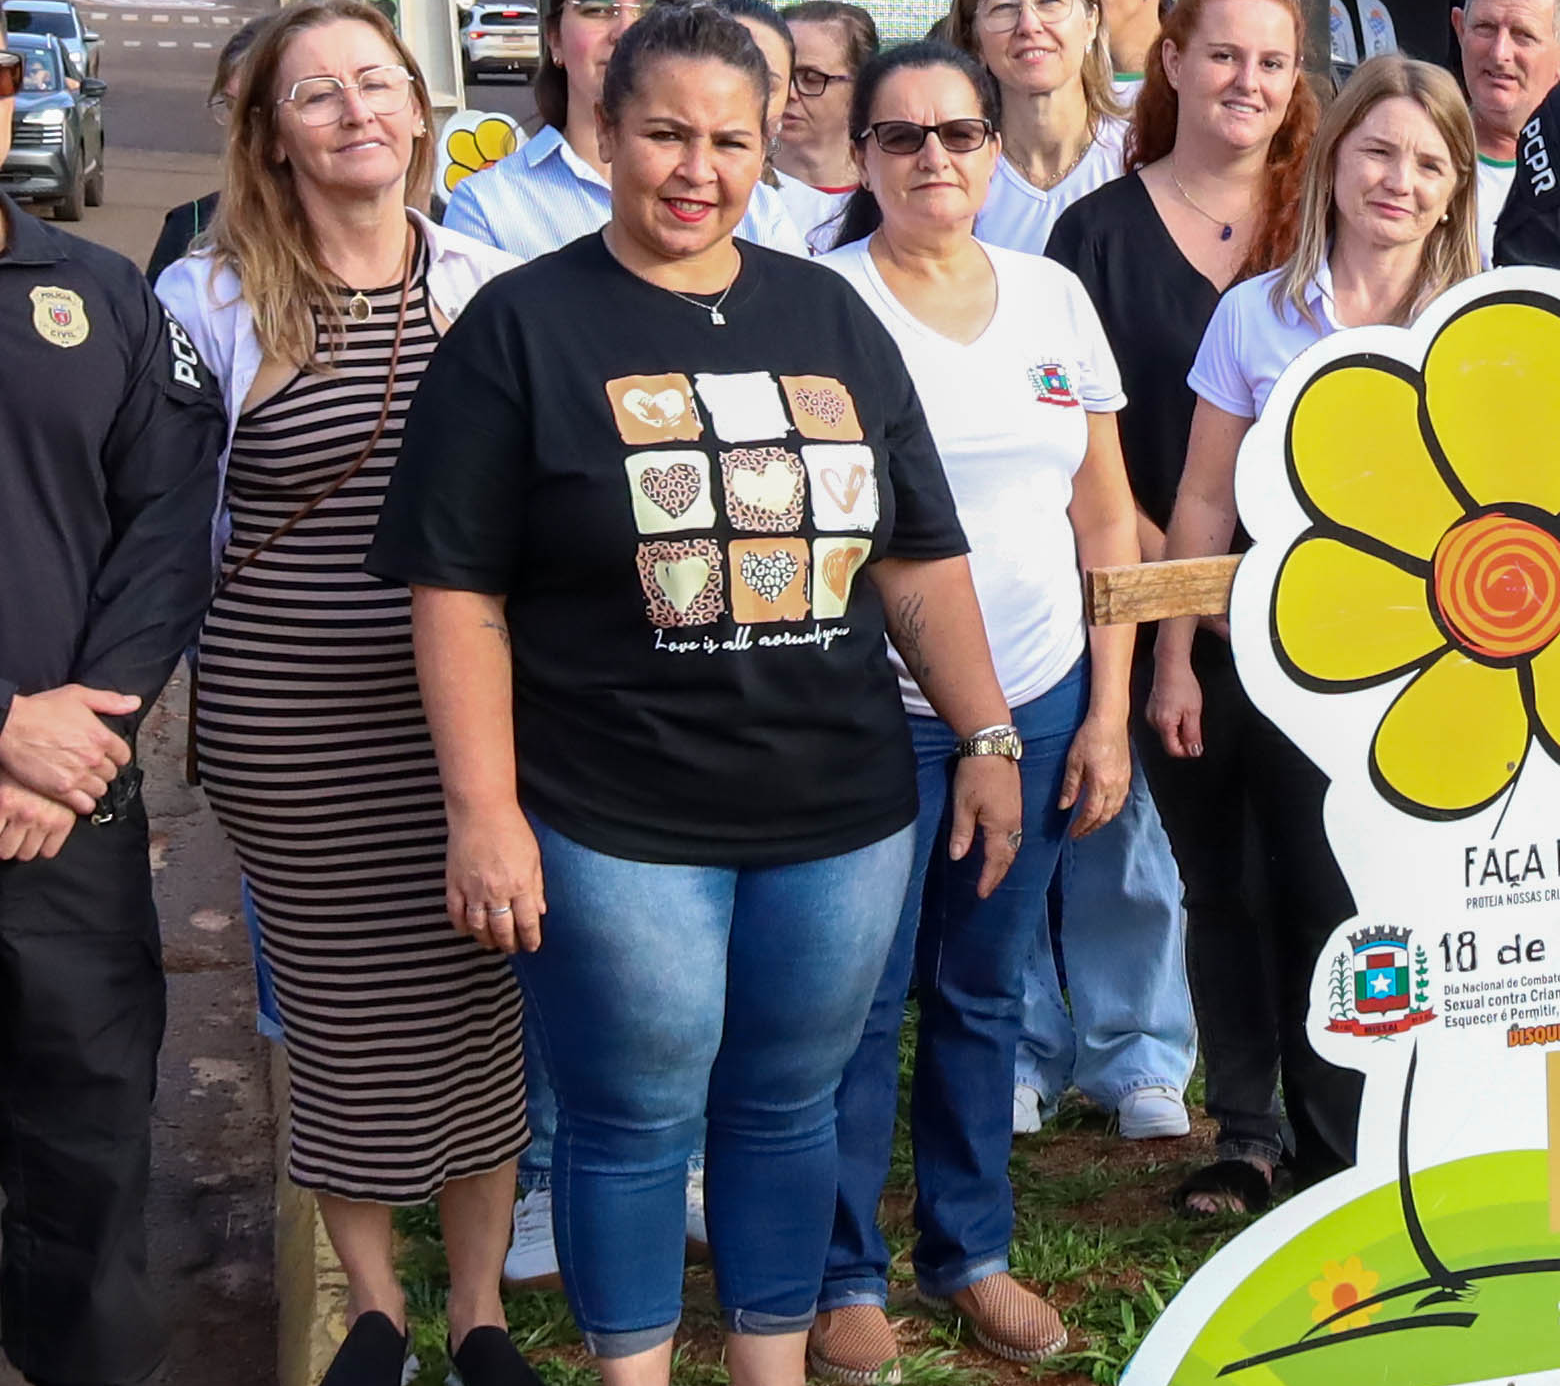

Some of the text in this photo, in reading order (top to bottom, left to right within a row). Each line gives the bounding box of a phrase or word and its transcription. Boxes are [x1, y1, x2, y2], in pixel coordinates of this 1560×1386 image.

[1521, 117, 1557, 197] PCPR
[654, 628, 700, 654] Love
[703, 635, 719, 655] is
[722, 625, 753, 651] all
[1465, 843, 1545, 888] FAÇA
[1466, 895, 1504, 909] PROTEJA
[1506, 890, 1542, 905] NOSSAS
[1438, 930, 1479, 974] 18
[1497, 933, 1546, 965] de
[1444, 984, 1460, 995] Dia
[1462, 981, 1505, 994] Nacional
[1507, 979, 1519, 989] de
[1444, 997, 1485, 1012] Sexual
[1488, 992, 1527, 1007] contra
[1445, 1014, 1497, 1029] Esquecer
[1501, 1011, 1507, 1022] é
[1511, 1004, 1560, 1021] Permitir,
